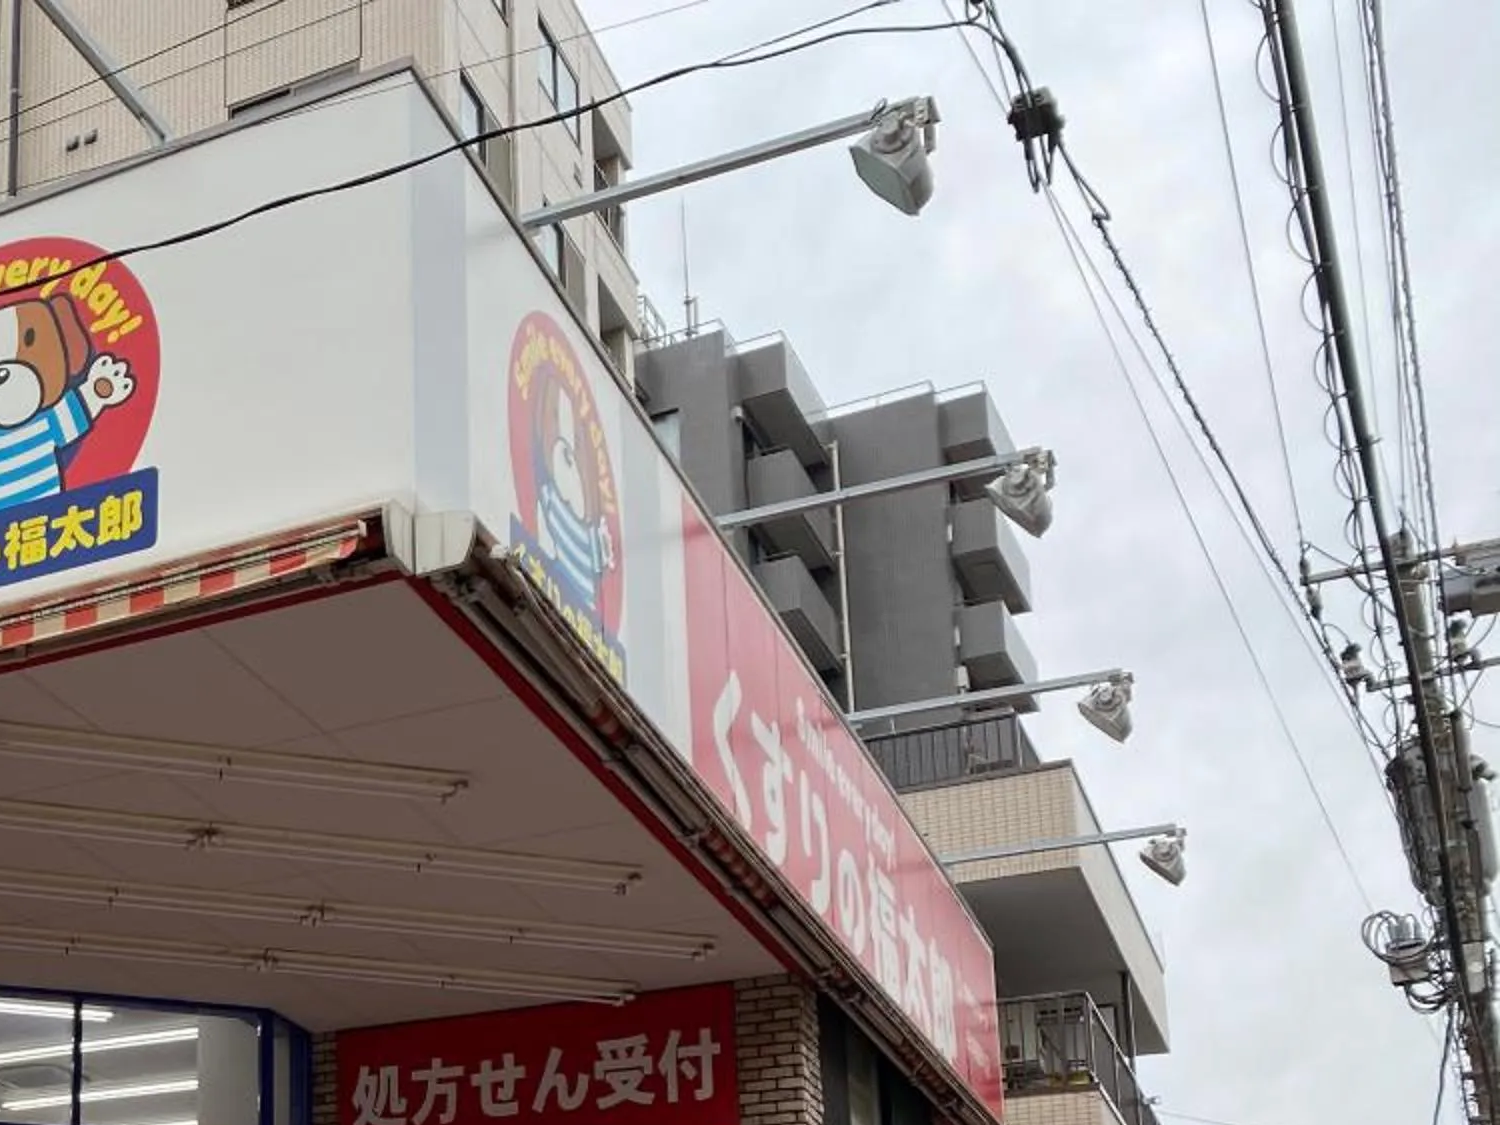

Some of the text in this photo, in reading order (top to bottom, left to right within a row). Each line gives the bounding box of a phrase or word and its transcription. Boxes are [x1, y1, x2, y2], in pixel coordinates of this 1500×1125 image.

[69, 262, 143, 343] day!
[712, 669, 959, 1067] くすりの福太郎
